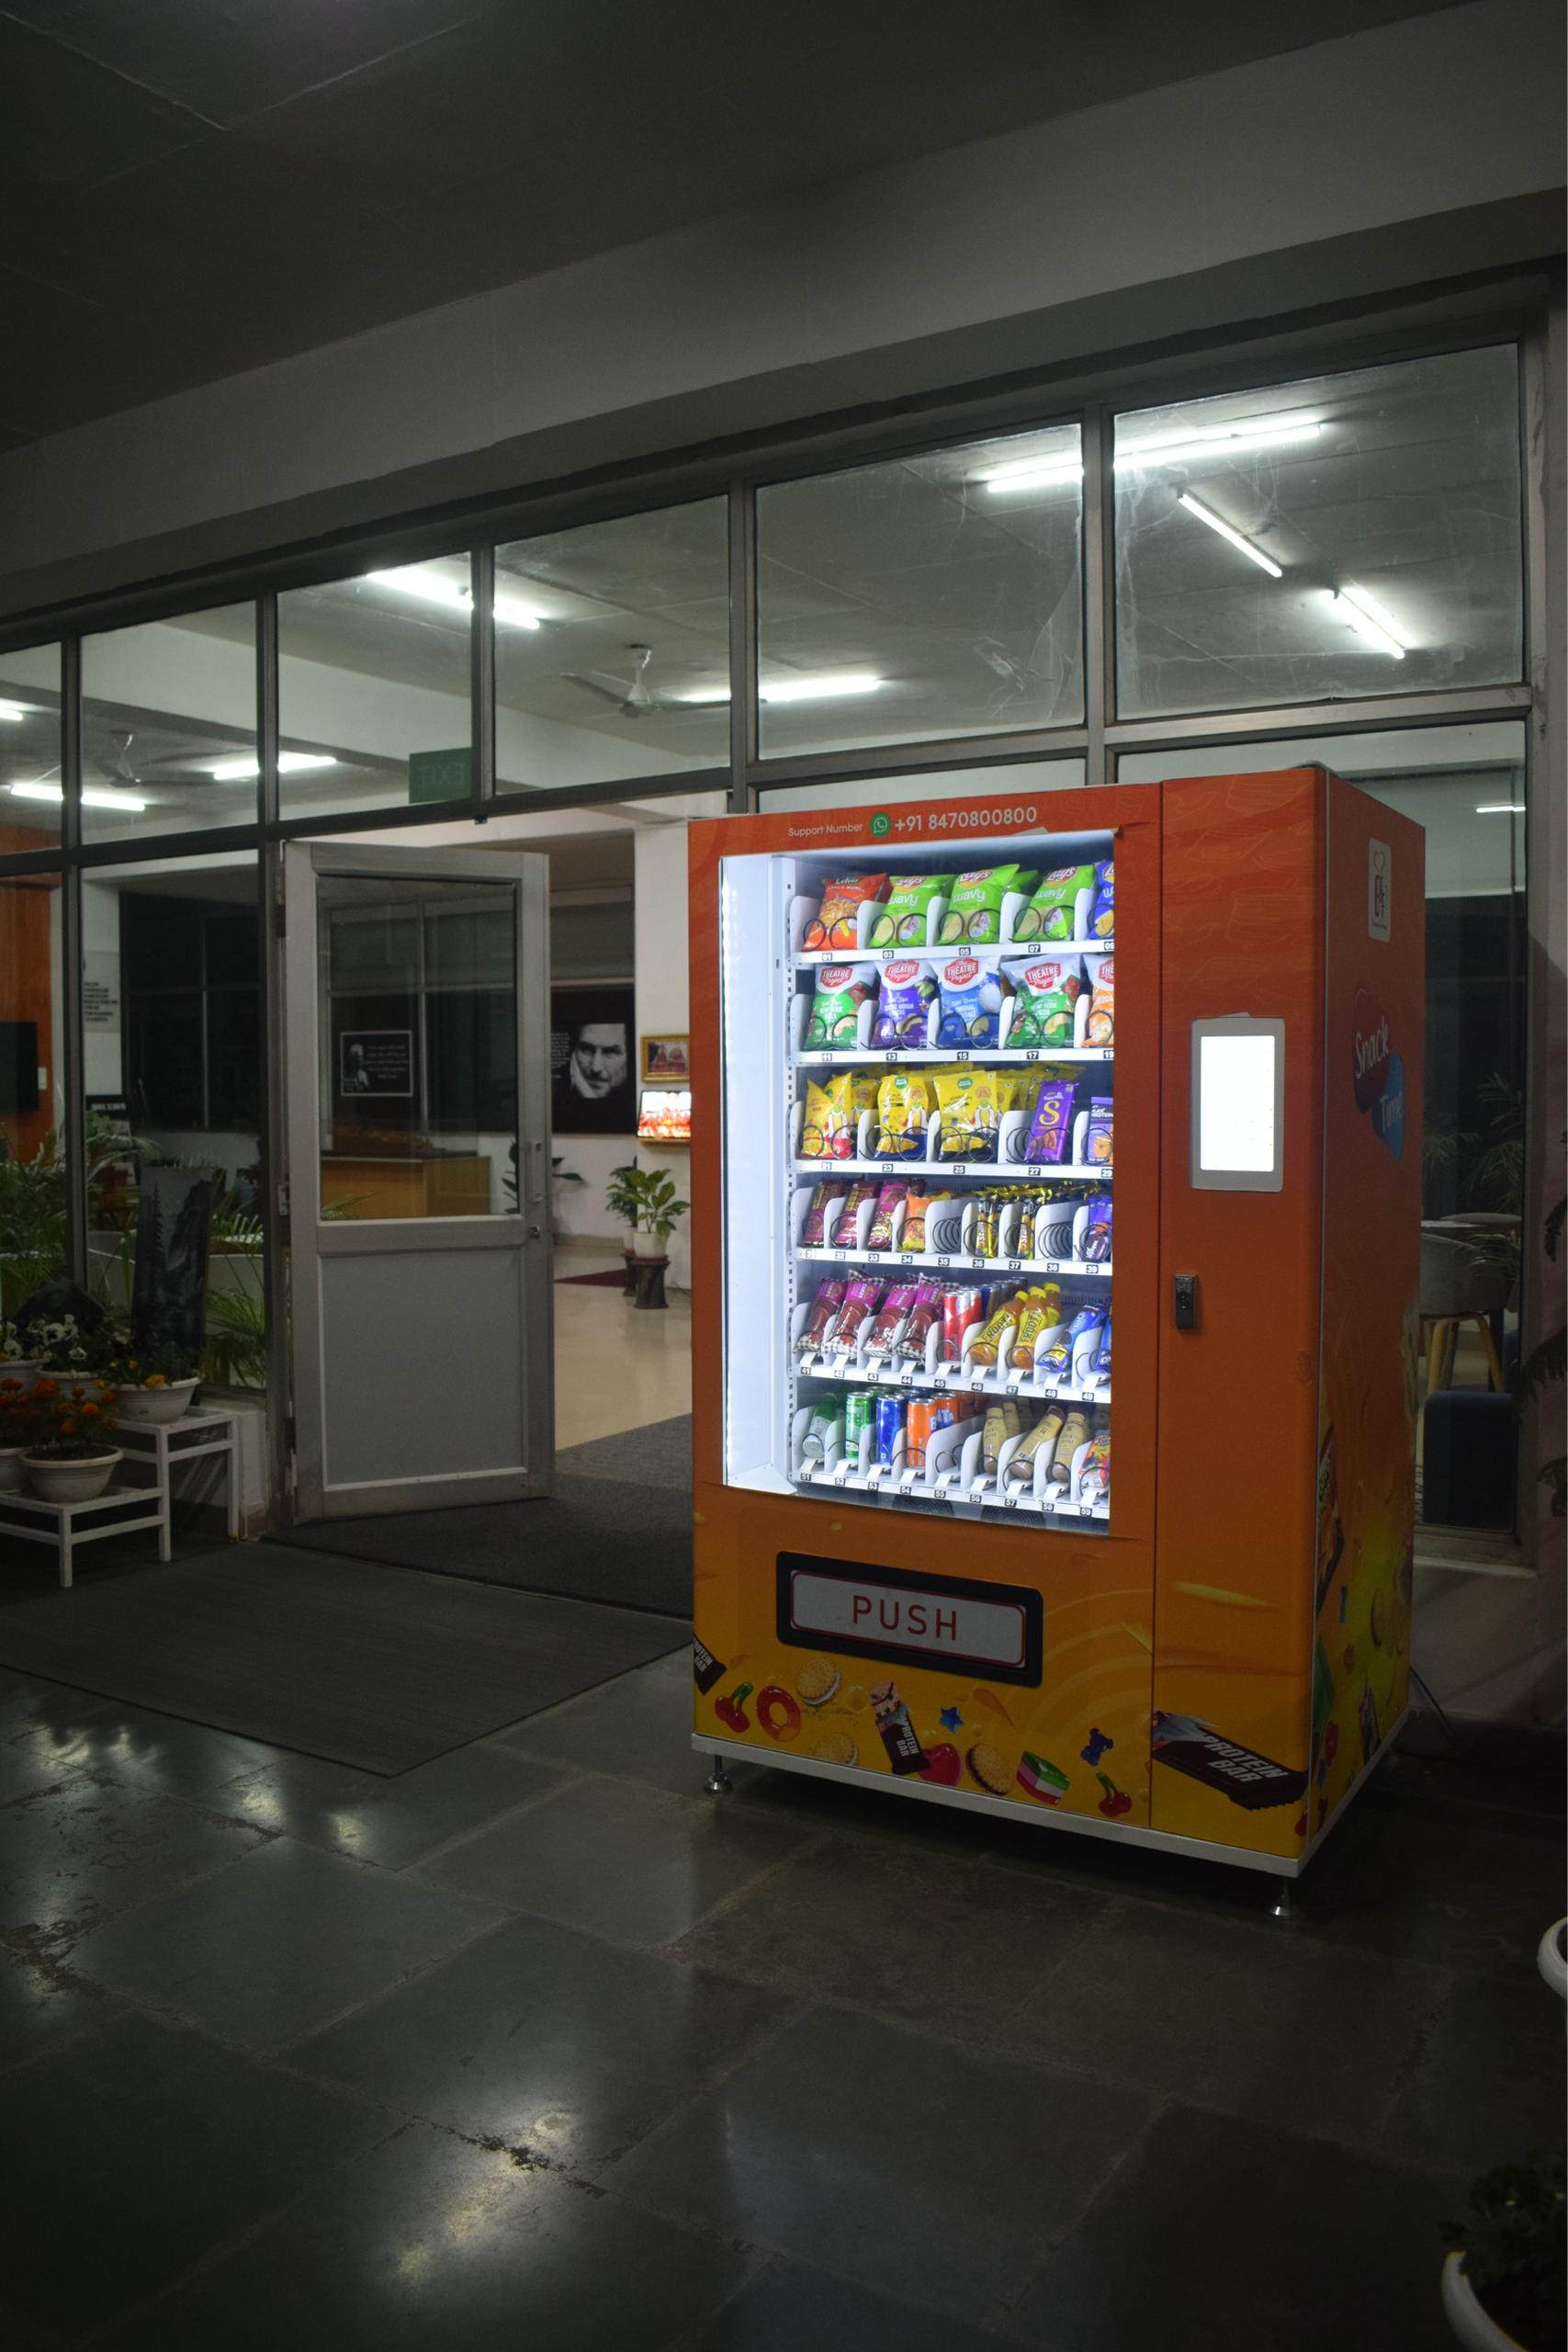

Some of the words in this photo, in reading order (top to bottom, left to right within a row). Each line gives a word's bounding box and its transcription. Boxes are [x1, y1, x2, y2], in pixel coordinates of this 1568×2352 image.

[788, 827, 825, 838] Support
[826, 823, 863, 834] Number
[895, 814, 922, 832] +91
[928, 807, 1037, 831] 8470800800
[886, 894, 919, 907] wavy
[953, 889, 986, 903] wavy
[1035, 888, 1067, 900] wavy
[886, 964, 917, 975] THEATRE
[947, 963, 977, 977] THEATRE
[1027, 965, 1059, 980] THEATRE
[1356, 1014, 1389, 1079] Snack
[1088, 1265, 1098, 1273] 39
[1007, 1385, 1018, 1394] 47
[1046, 1389, 1056, 1397] 48
[1043, 1502, 1054, 1510] 58
[1081, 1508, 1091, 1516] 59
[852, 1595, 956, 1641] PUSH
[901, 1720, 919, 1755] PROTEIN
[896, 1739, 910, 1757] BAR
[1202, 1735, 1291, 1779] PROTEIN
[1206, 1759, 1264, 1782] BAR
